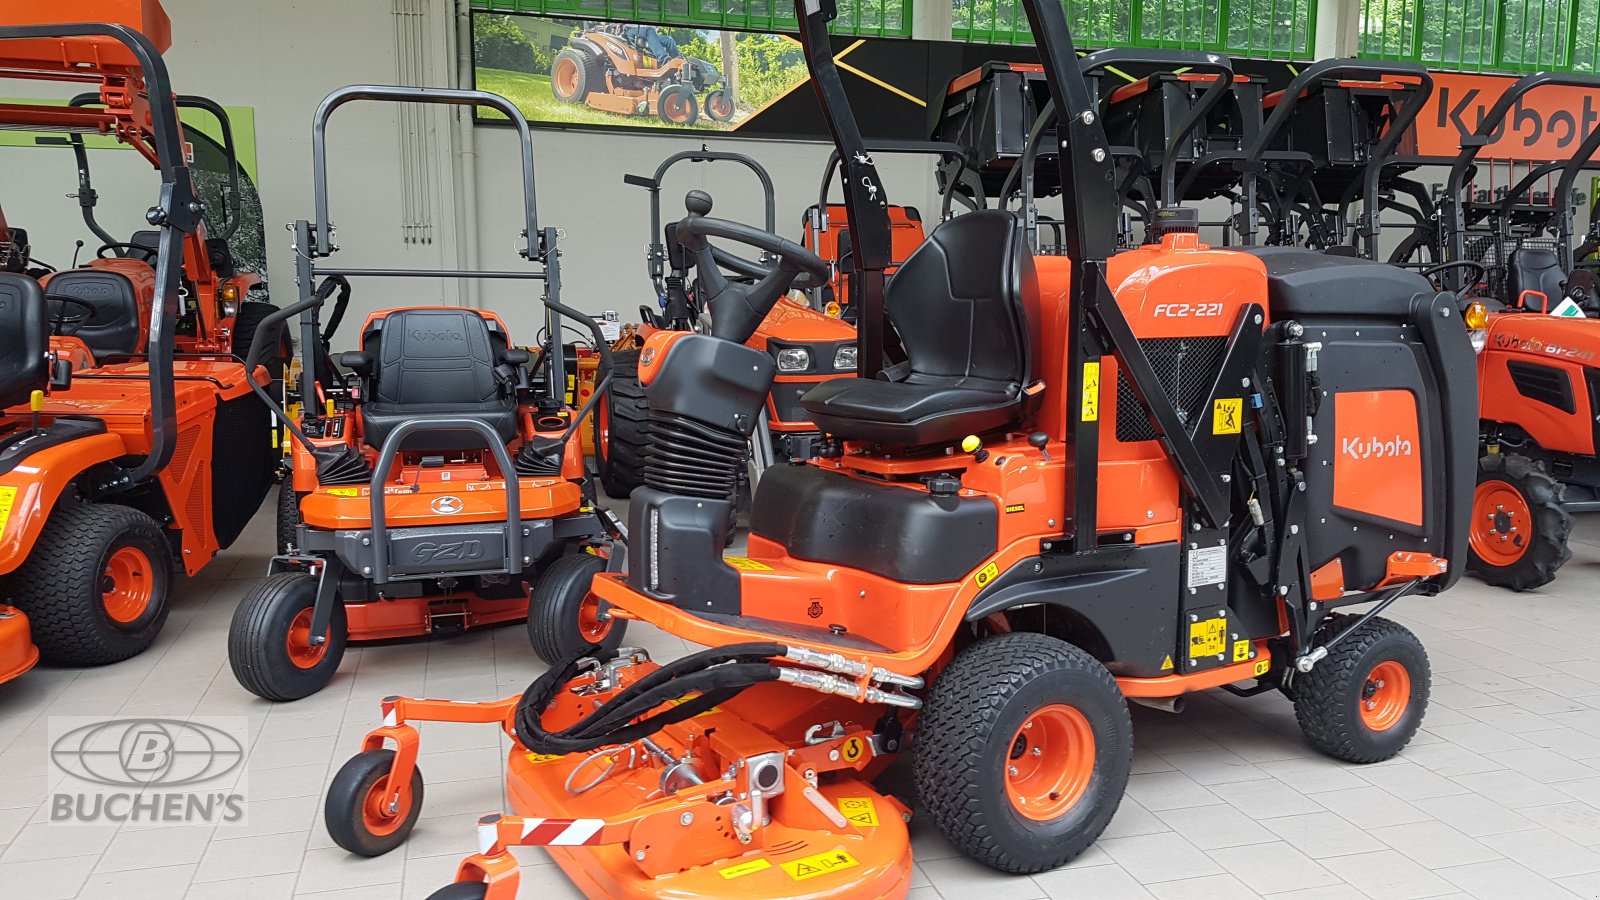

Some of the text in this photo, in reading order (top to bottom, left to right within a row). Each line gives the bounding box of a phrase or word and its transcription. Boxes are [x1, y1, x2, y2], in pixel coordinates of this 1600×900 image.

[1153, 303, 1224, 318] FC2-221
[408, 329, 462, 342] Kubota
[1342, 434, 1412, 460] Kubota
[1006, 505, 1025, 514] DIESEL
[410, 539, 485, 565] GZD
